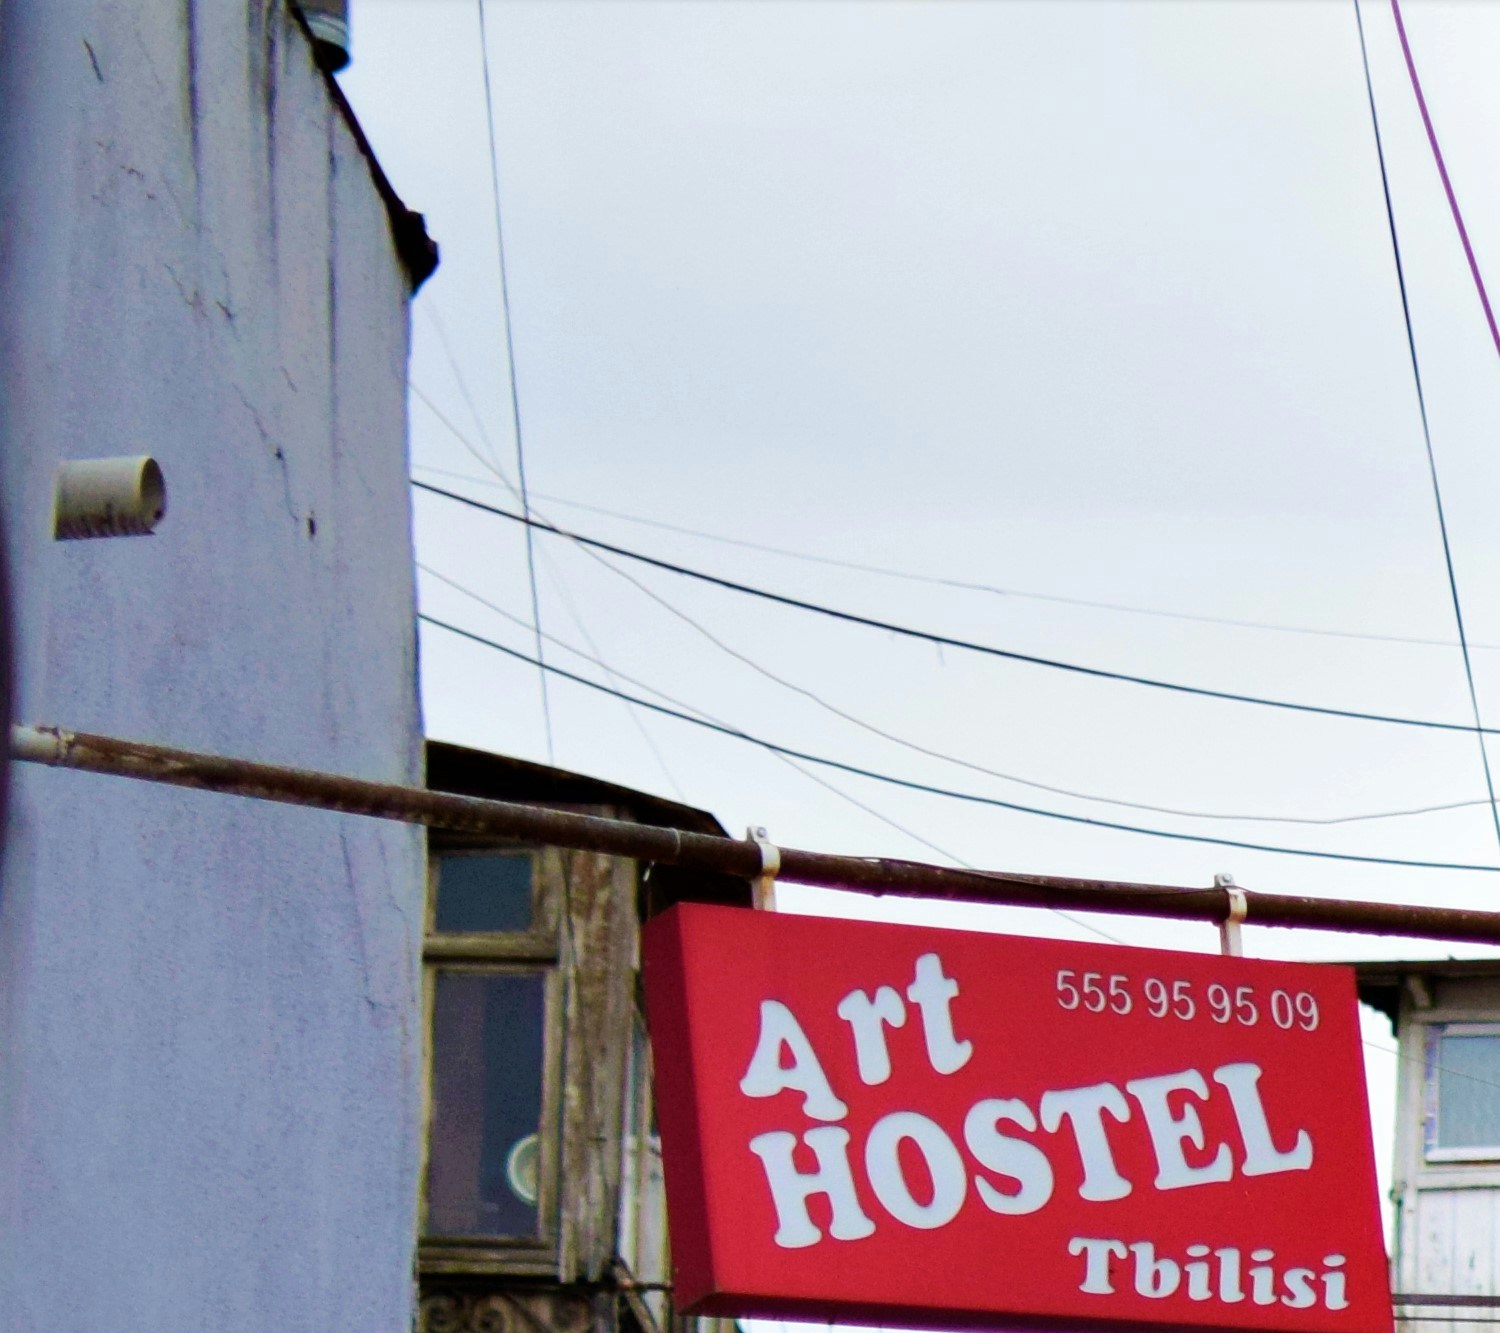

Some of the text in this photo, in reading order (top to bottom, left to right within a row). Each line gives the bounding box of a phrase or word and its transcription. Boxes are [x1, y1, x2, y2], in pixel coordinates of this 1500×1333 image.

[740, 952, 973, 1121] Art
[1056, 970, 1320, 1031] 555 95 95 09
[749, 1062, 1313, 1248] HOSTEL
[1068, 1237, 1349, 1310] Tbilisi
